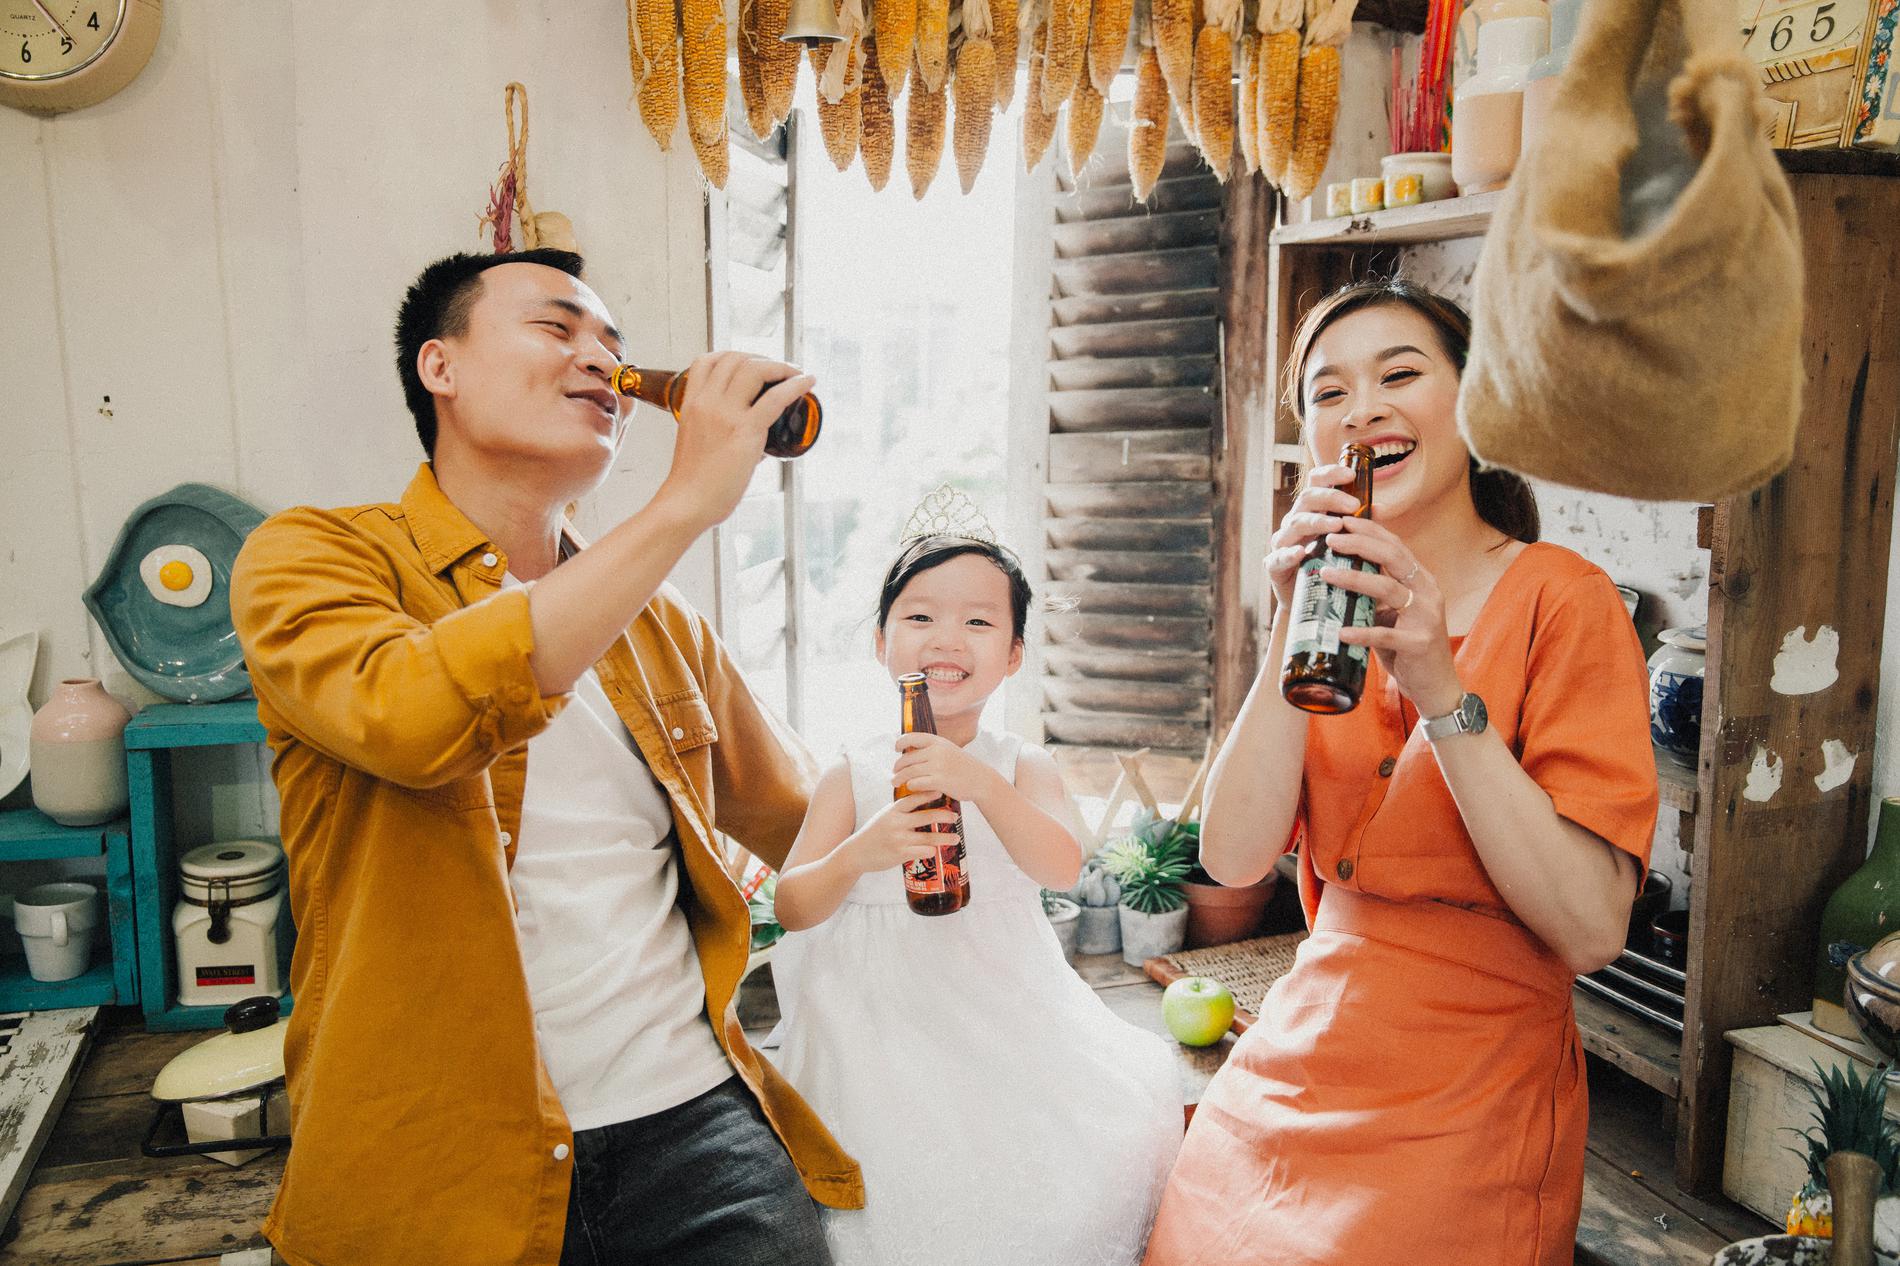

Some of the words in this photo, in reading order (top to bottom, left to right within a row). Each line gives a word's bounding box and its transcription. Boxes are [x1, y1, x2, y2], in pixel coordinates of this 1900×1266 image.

[86, 11, 100, 31] 4
[1770, 15, 1794, 52] 6
[1810, 2, 1836, 42] 5
[21, 40, 32, 63] 6
[60, 36, 73, 56] 5
